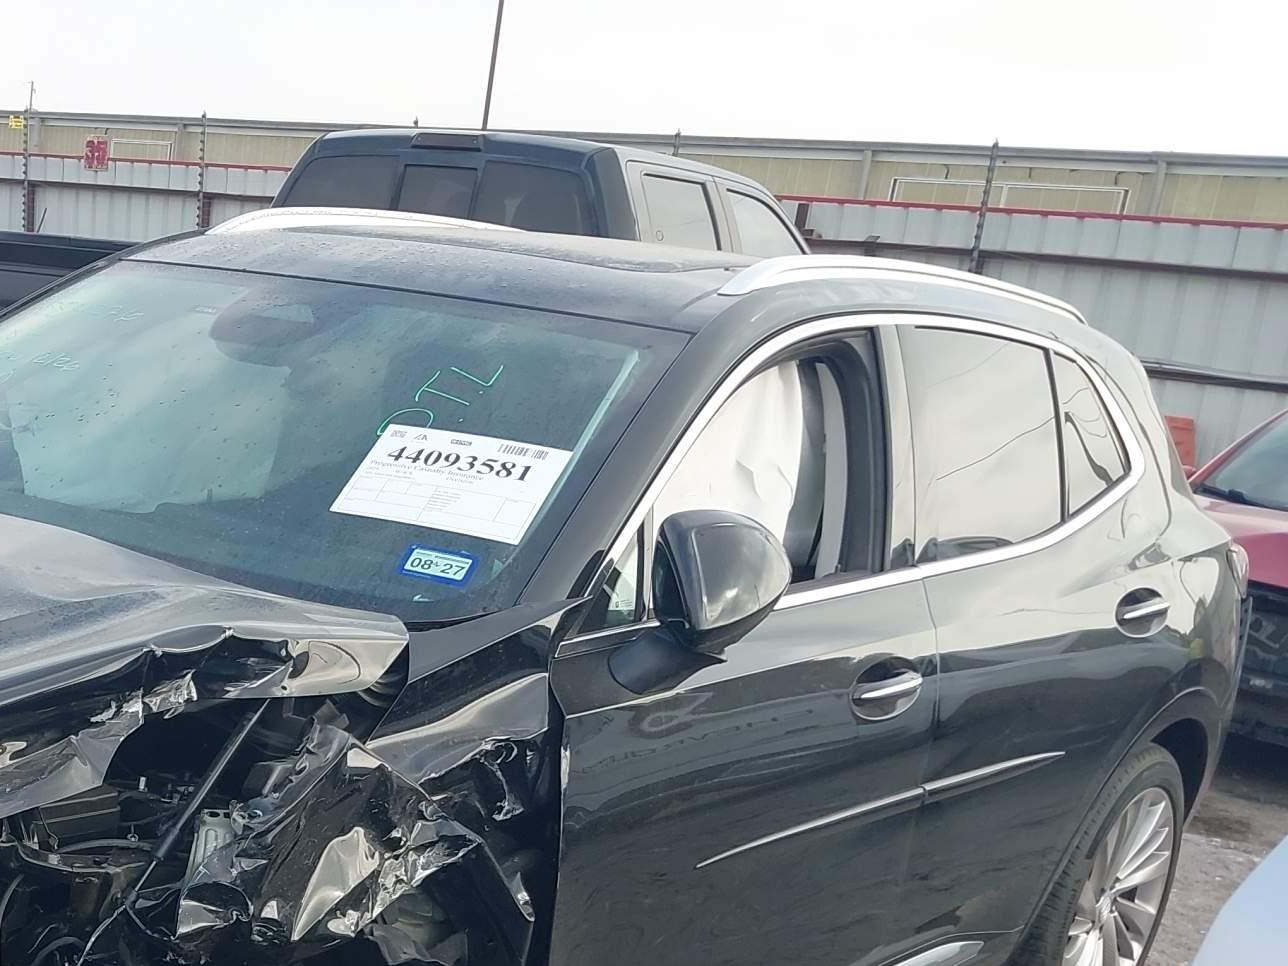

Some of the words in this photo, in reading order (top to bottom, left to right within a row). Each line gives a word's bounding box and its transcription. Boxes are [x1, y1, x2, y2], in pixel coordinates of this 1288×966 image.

[387, 446, 533, 482] 44093581
[410, 557, 434, 570] 08
[439, 562, 467, 576] 27
